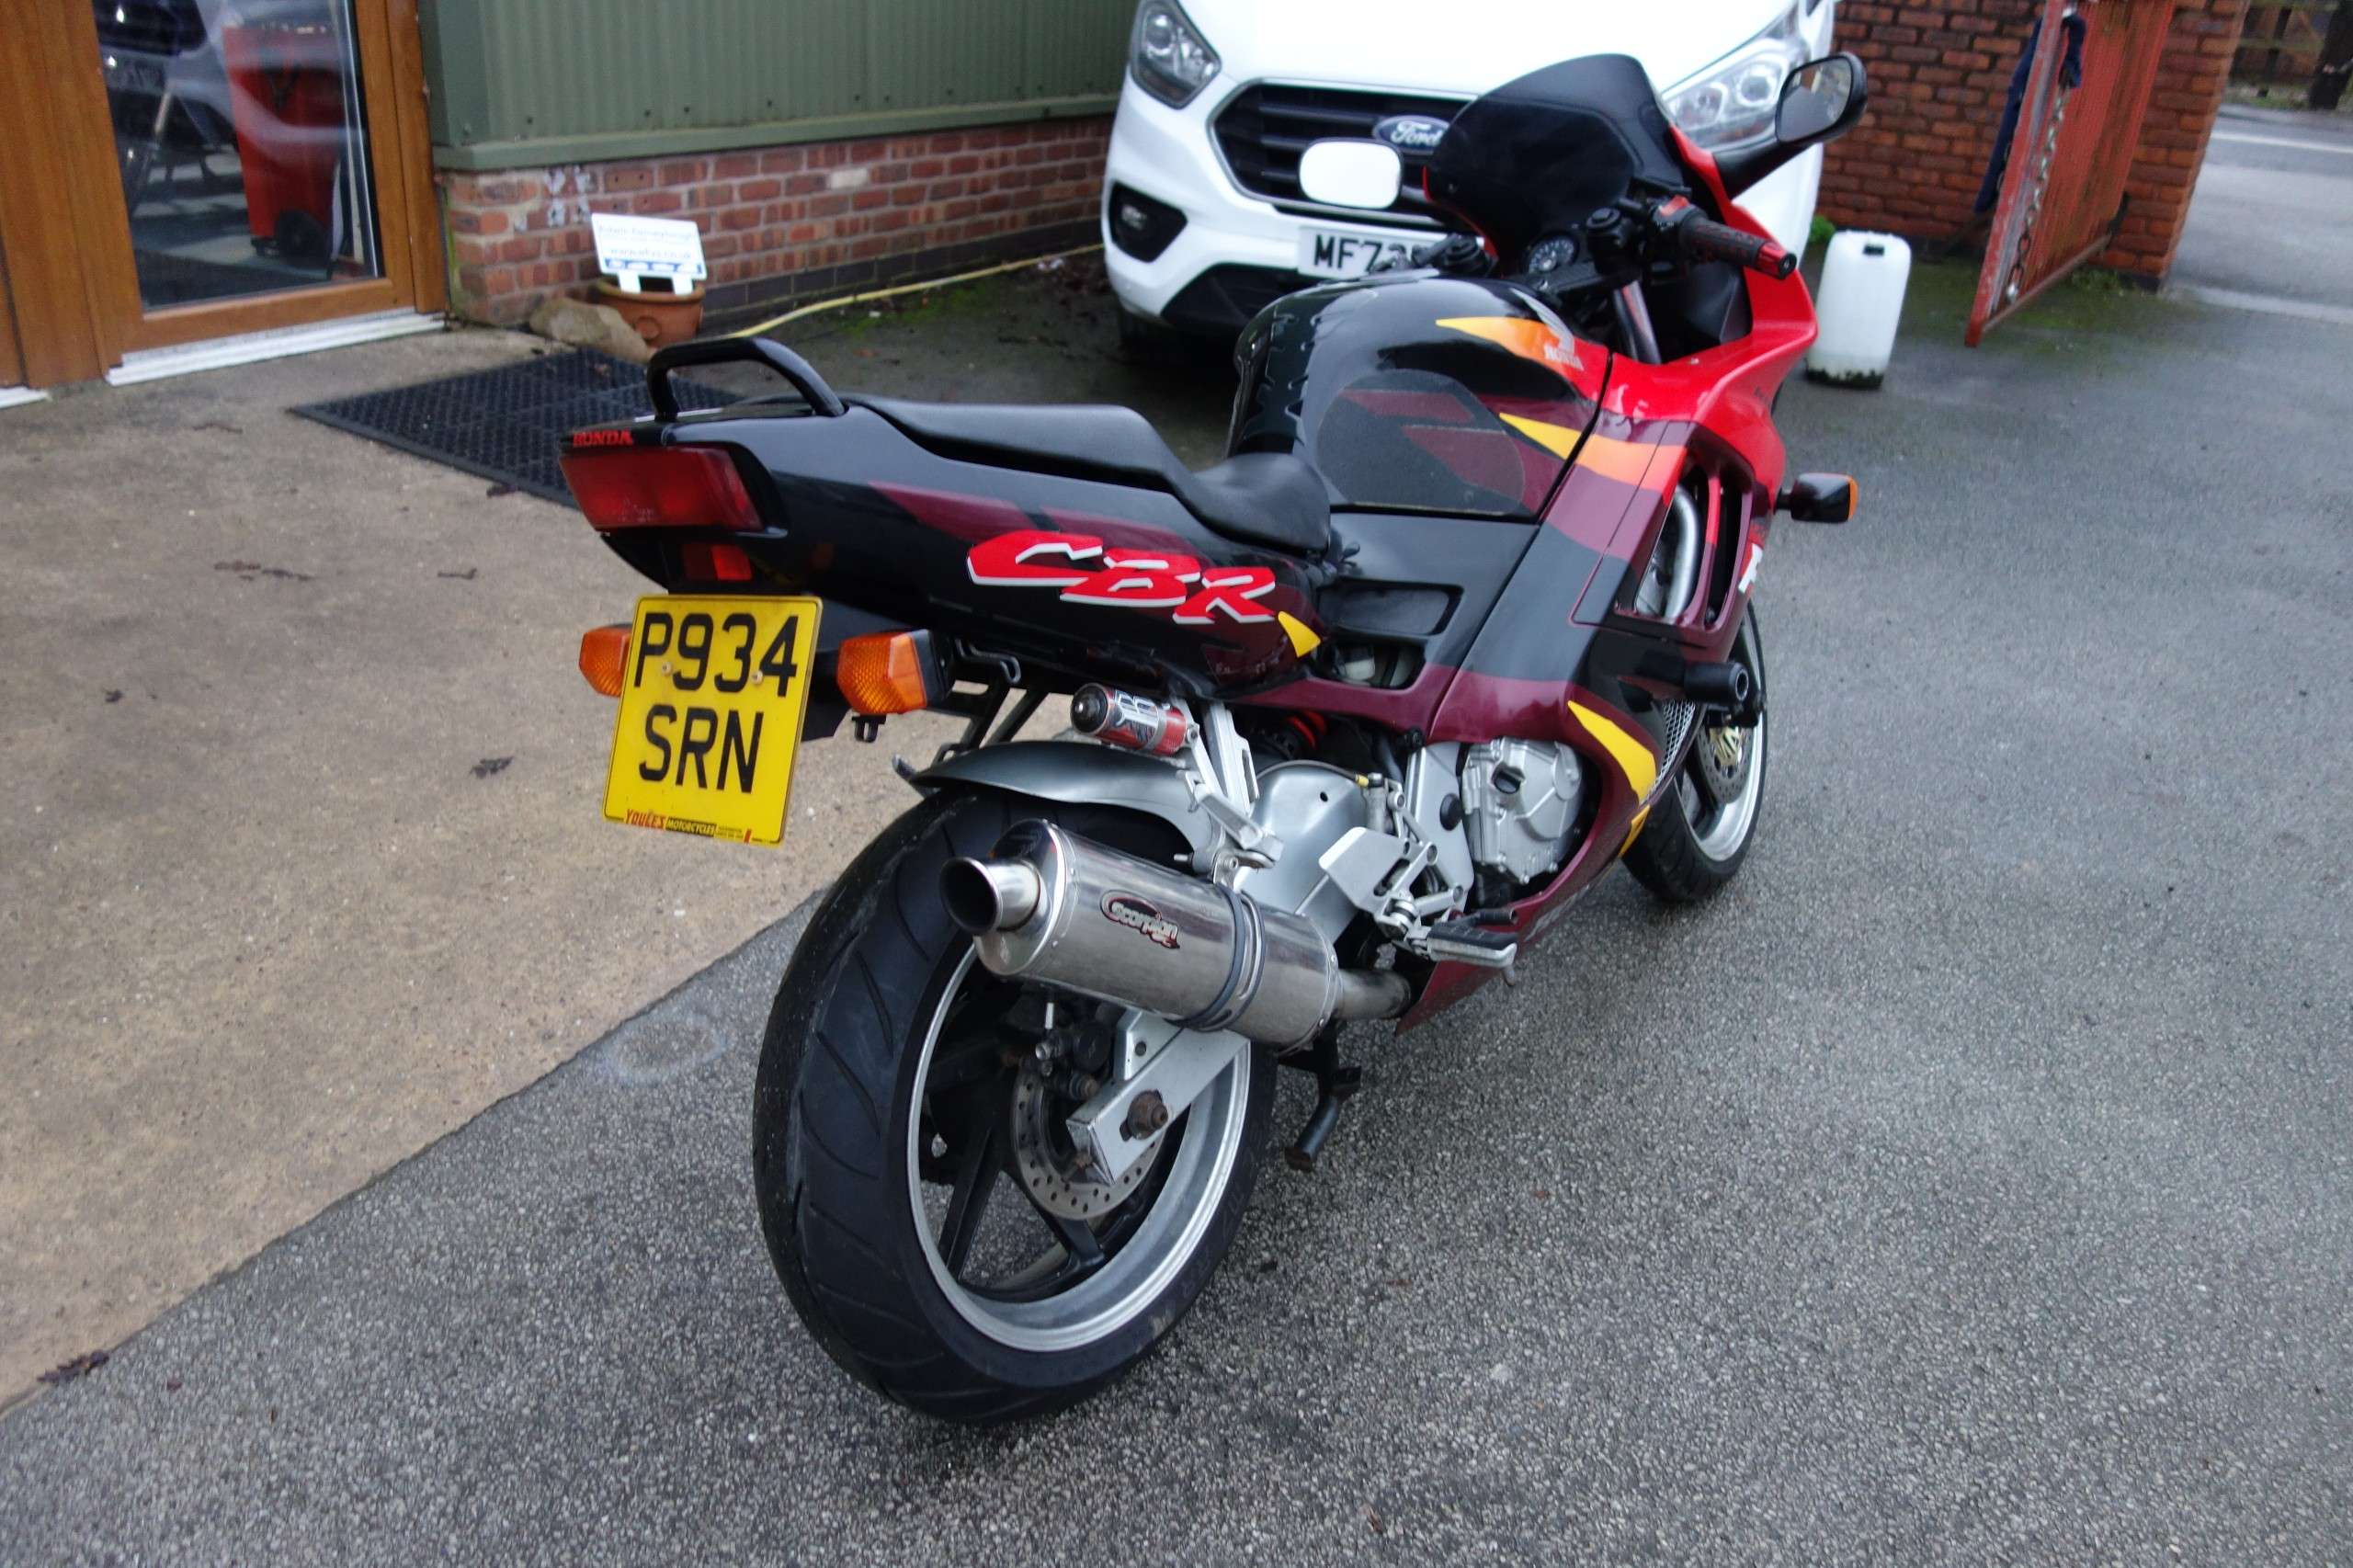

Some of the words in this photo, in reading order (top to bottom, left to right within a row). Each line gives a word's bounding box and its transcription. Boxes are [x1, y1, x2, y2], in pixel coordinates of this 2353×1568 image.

[1391, 120, 1443, 147] Ford
[574, 428, 633, 447] HONDA
[967, 529, 1276, 624] CBR
[633, 612, 800, 698] P934
[638, 704, 764, 794] SRN
[667, 818, 716, 837] MOTORCYCLES
